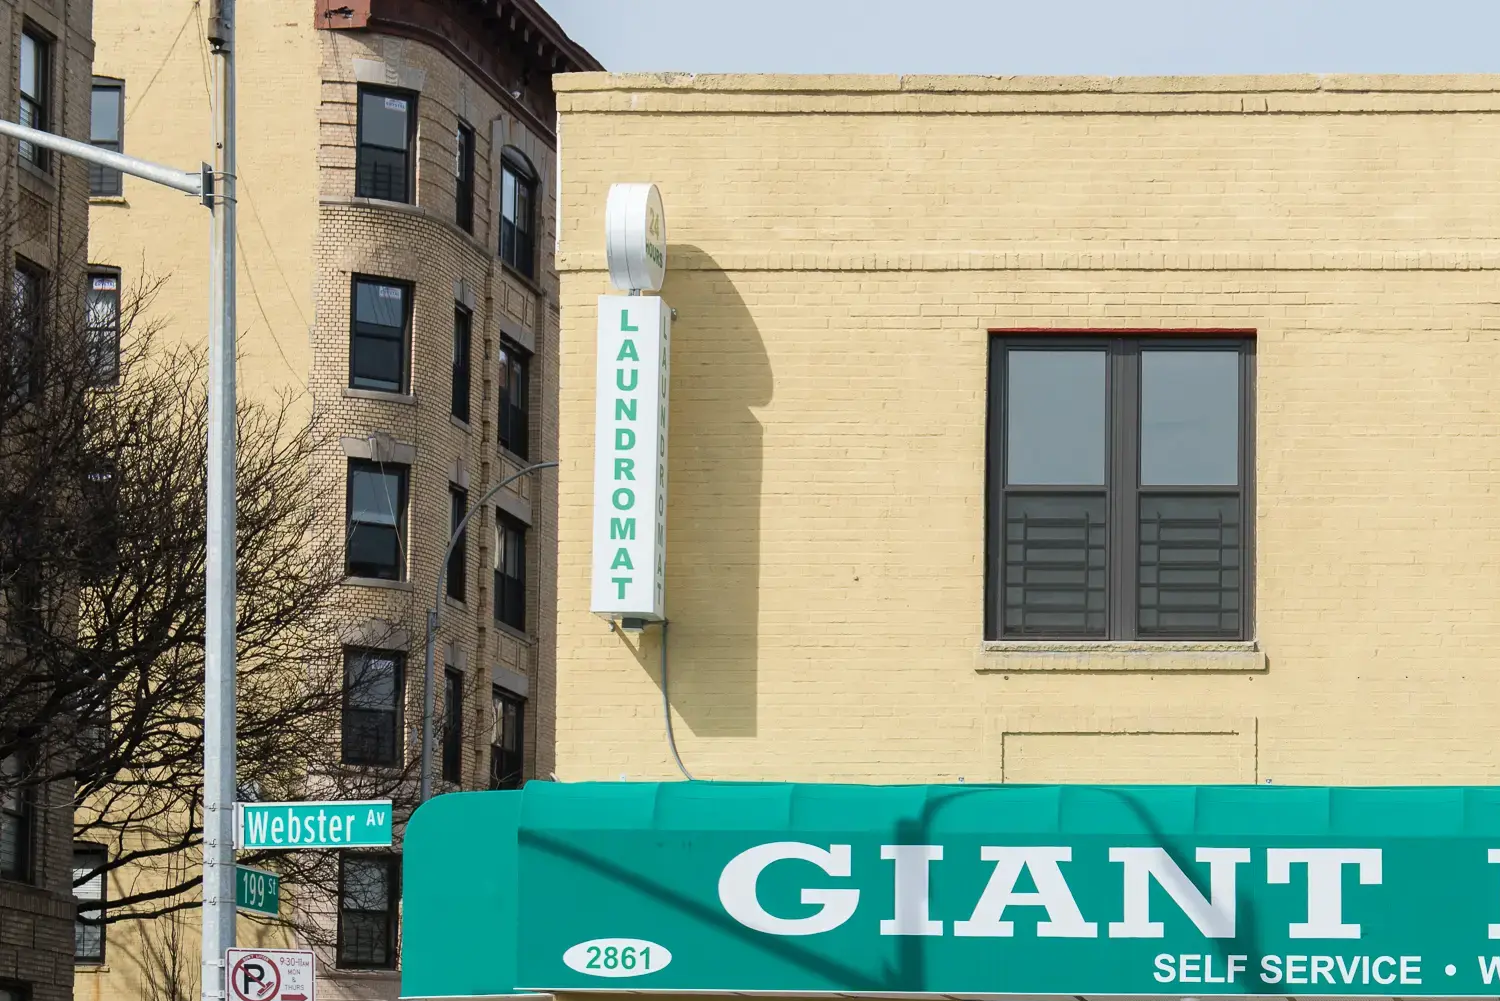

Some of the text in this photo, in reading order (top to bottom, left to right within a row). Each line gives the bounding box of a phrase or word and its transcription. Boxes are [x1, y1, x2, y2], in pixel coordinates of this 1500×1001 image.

[648, 206, 660, 240] 24
[645, 241, 663, 269] HOURS
[609, 308, 640, 601] LAUNDROMAT
[656, 317, 668, 606] LAUNDROMAT
[248, 808, 385, 844] Webster Av
[243, 873, 276, 908] 199 St
[718, 841, 1383, 939] GIANT
[585, 944, 653, 970] 2861
[1153, 953, 1247, 984] SELF
[1259, 954, 1423, 986] SERVICE
